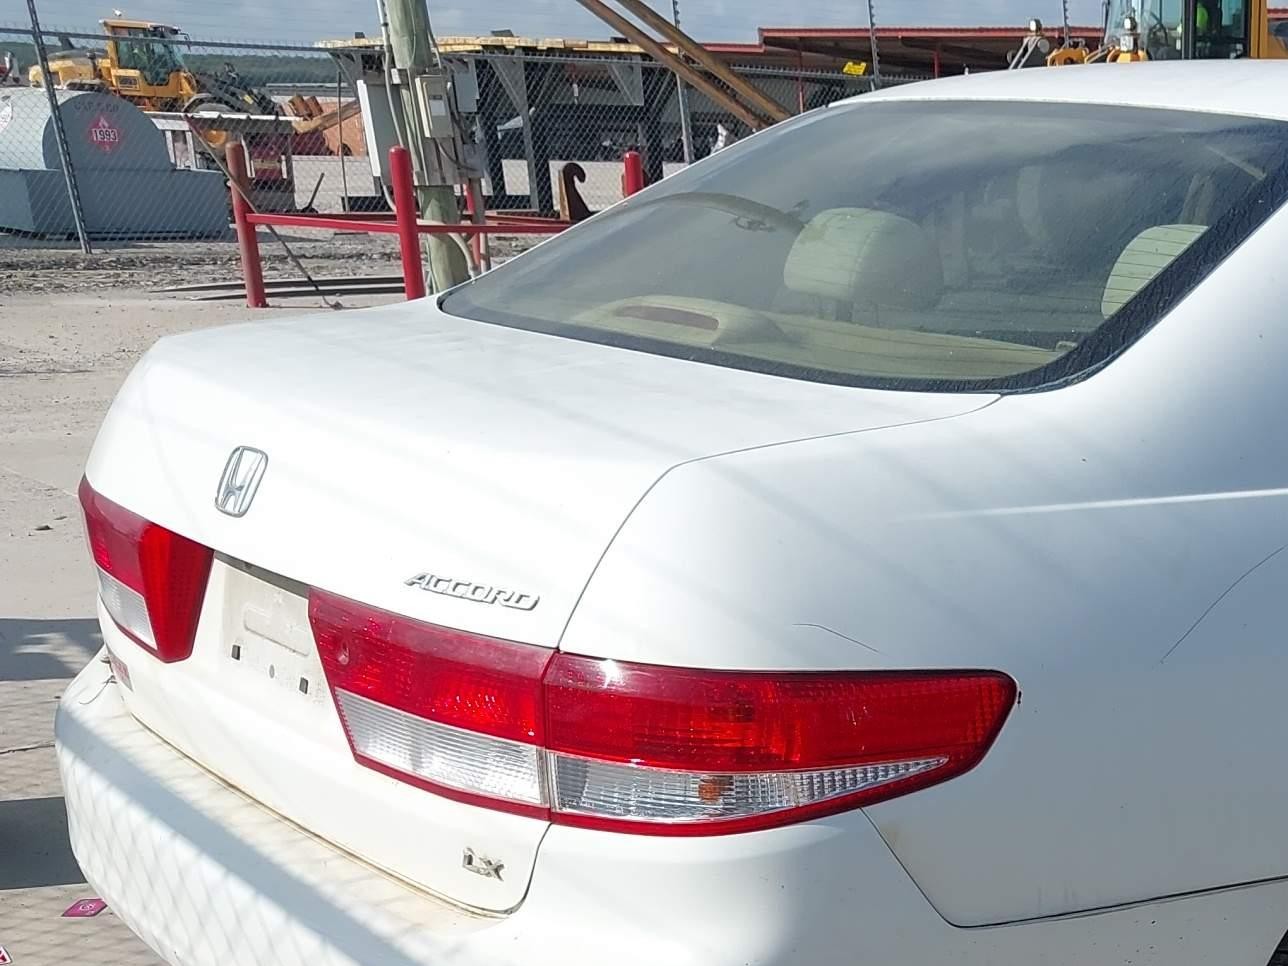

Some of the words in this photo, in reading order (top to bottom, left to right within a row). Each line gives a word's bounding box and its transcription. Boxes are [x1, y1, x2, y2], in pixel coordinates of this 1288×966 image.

[94, 129, 117, 141] 1993
[403, 572, 541, 611] ACCORD
[462, 846, 505, 882] LX
